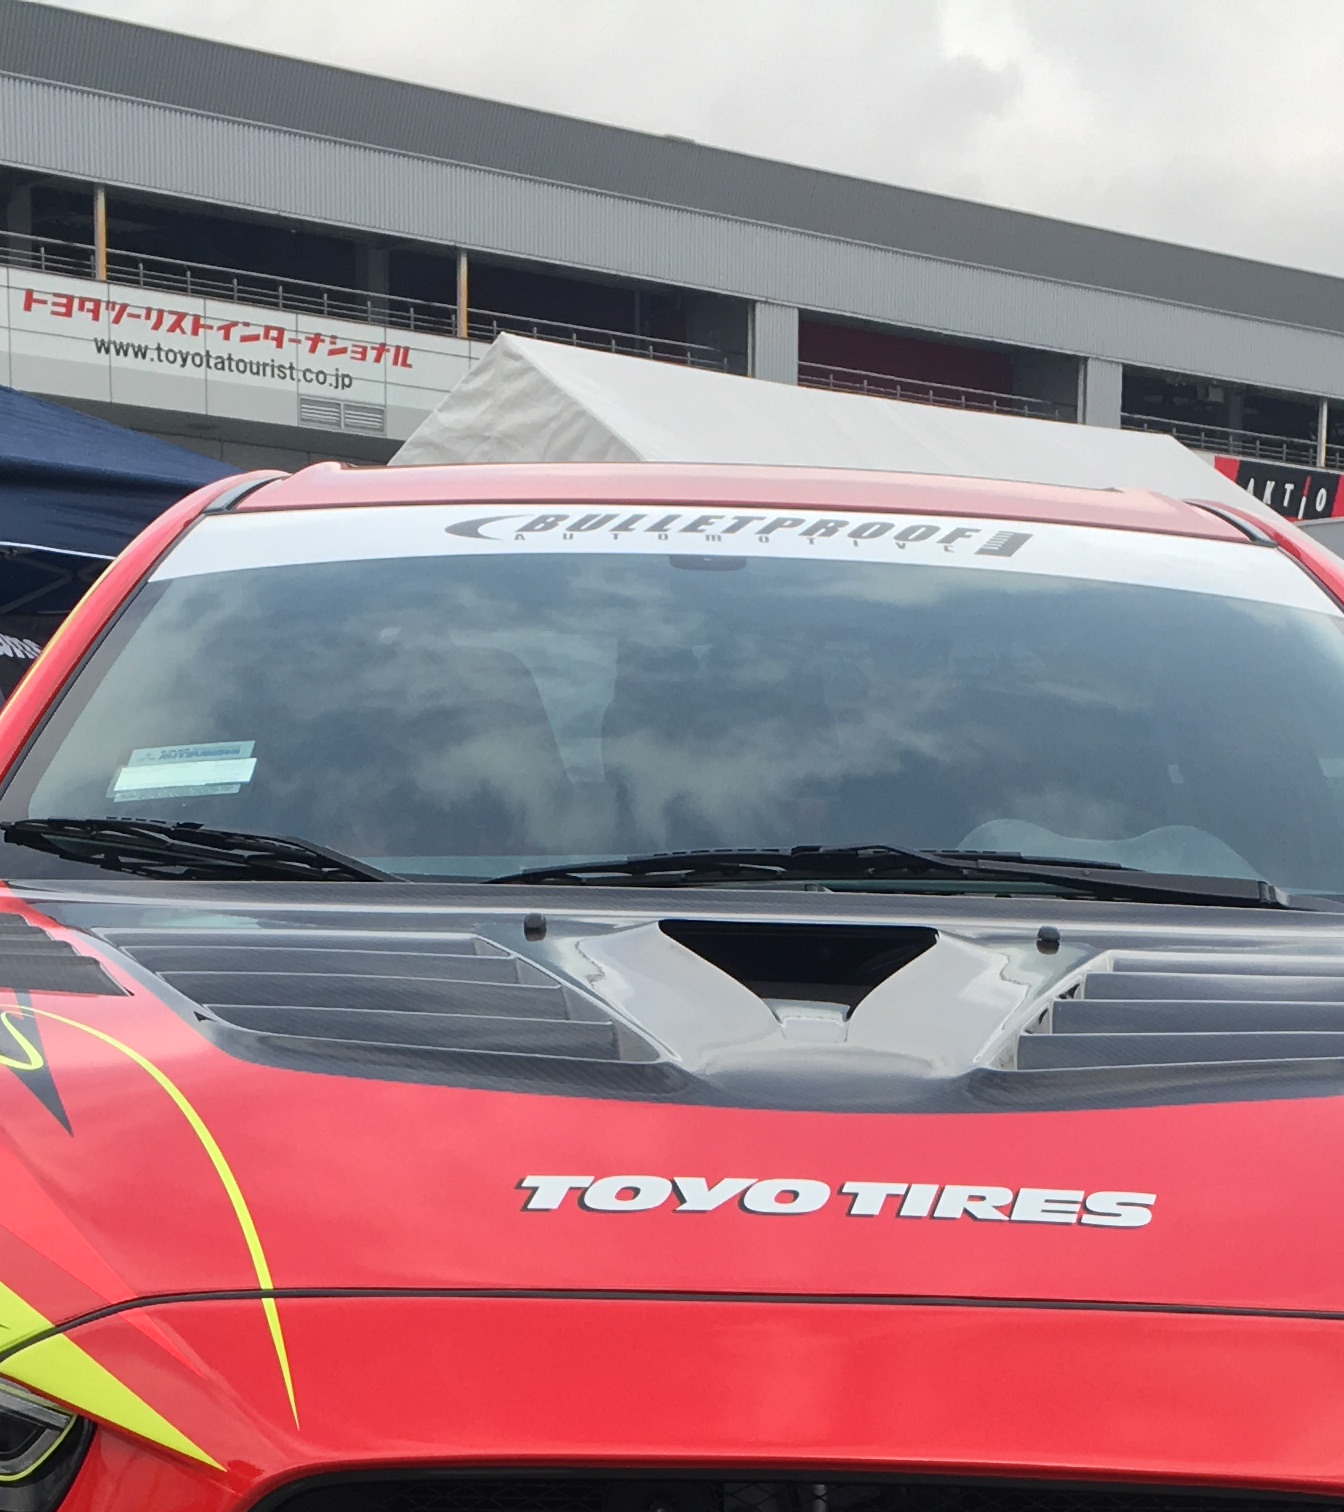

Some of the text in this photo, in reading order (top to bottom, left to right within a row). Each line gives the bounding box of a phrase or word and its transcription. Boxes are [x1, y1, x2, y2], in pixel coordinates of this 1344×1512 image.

[23, 288, 414, 369] トヨタツーリストインターナショナル
[94, 337, 354, 391] www.toyotatourist.co.jp
[520, 513, 982, 545] BULLETPROOF
[518, 1174, 1156, 1228] TOYO TIRES
